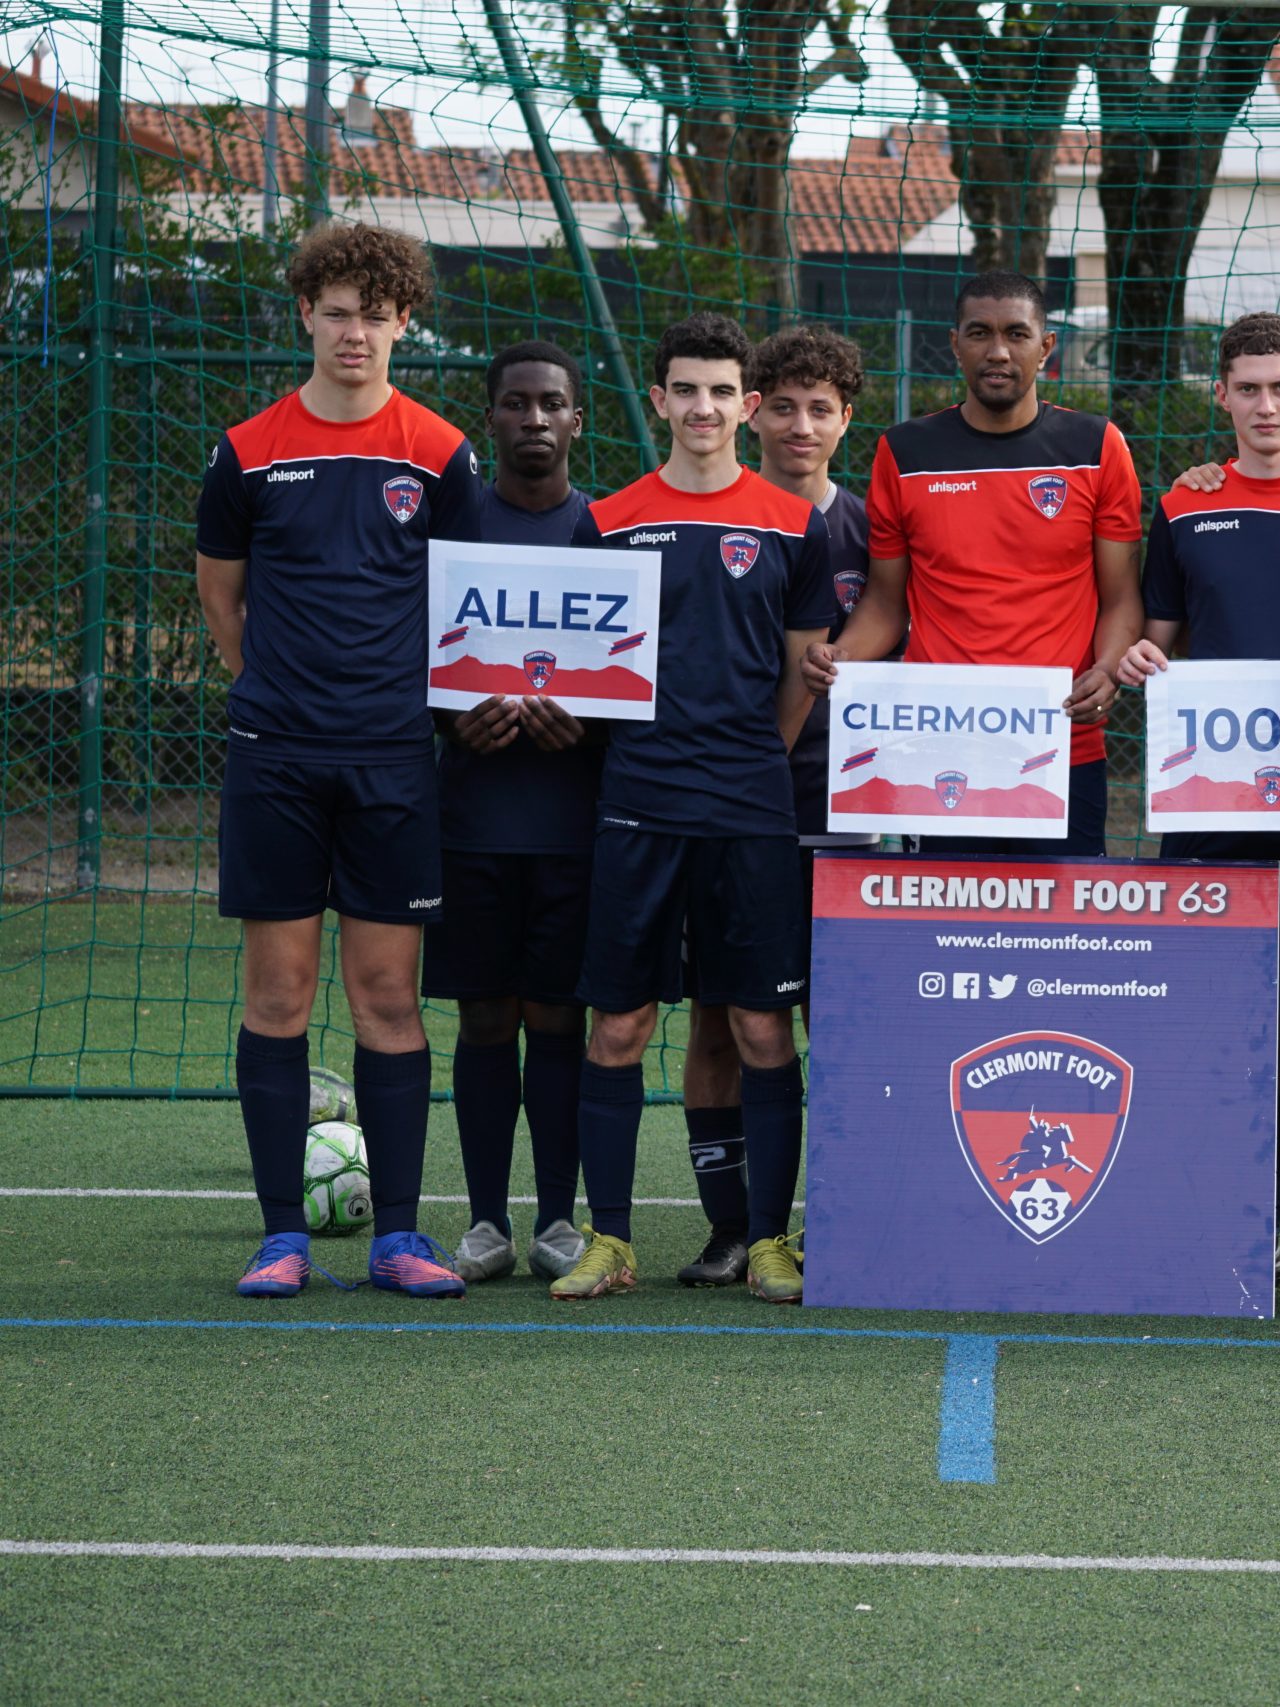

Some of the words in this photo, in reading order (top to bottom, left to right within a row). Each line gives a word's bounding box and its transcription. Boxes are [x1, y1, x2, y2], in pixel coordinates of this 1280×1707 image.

[267, 468, 314, 483] uhlsport
[929, 480, 977, 494] uhlsport
[1194, 519, 1240, 533] uhlsport
[629, 530, 677, 545] uhlsport
[454, 587, 629, 633] ALLEZ
[842, 702, 1062, 736] CLERMONT
[860, 874, 1056, 910] CLERMONT
[1073, 879, 1167, 913] FOOT
[1177, 881, 1228, 914] 63
[936, 931, 1153, 952] www.clermontfoot.com
[1027, 978, 1168, 998] @clermontfoot
[966, 1051, 1064, 1089] CLERMONT
[1066, 1055, 1117, 1090] FOOT
[1020, 1197, 1059, 1220] 63
